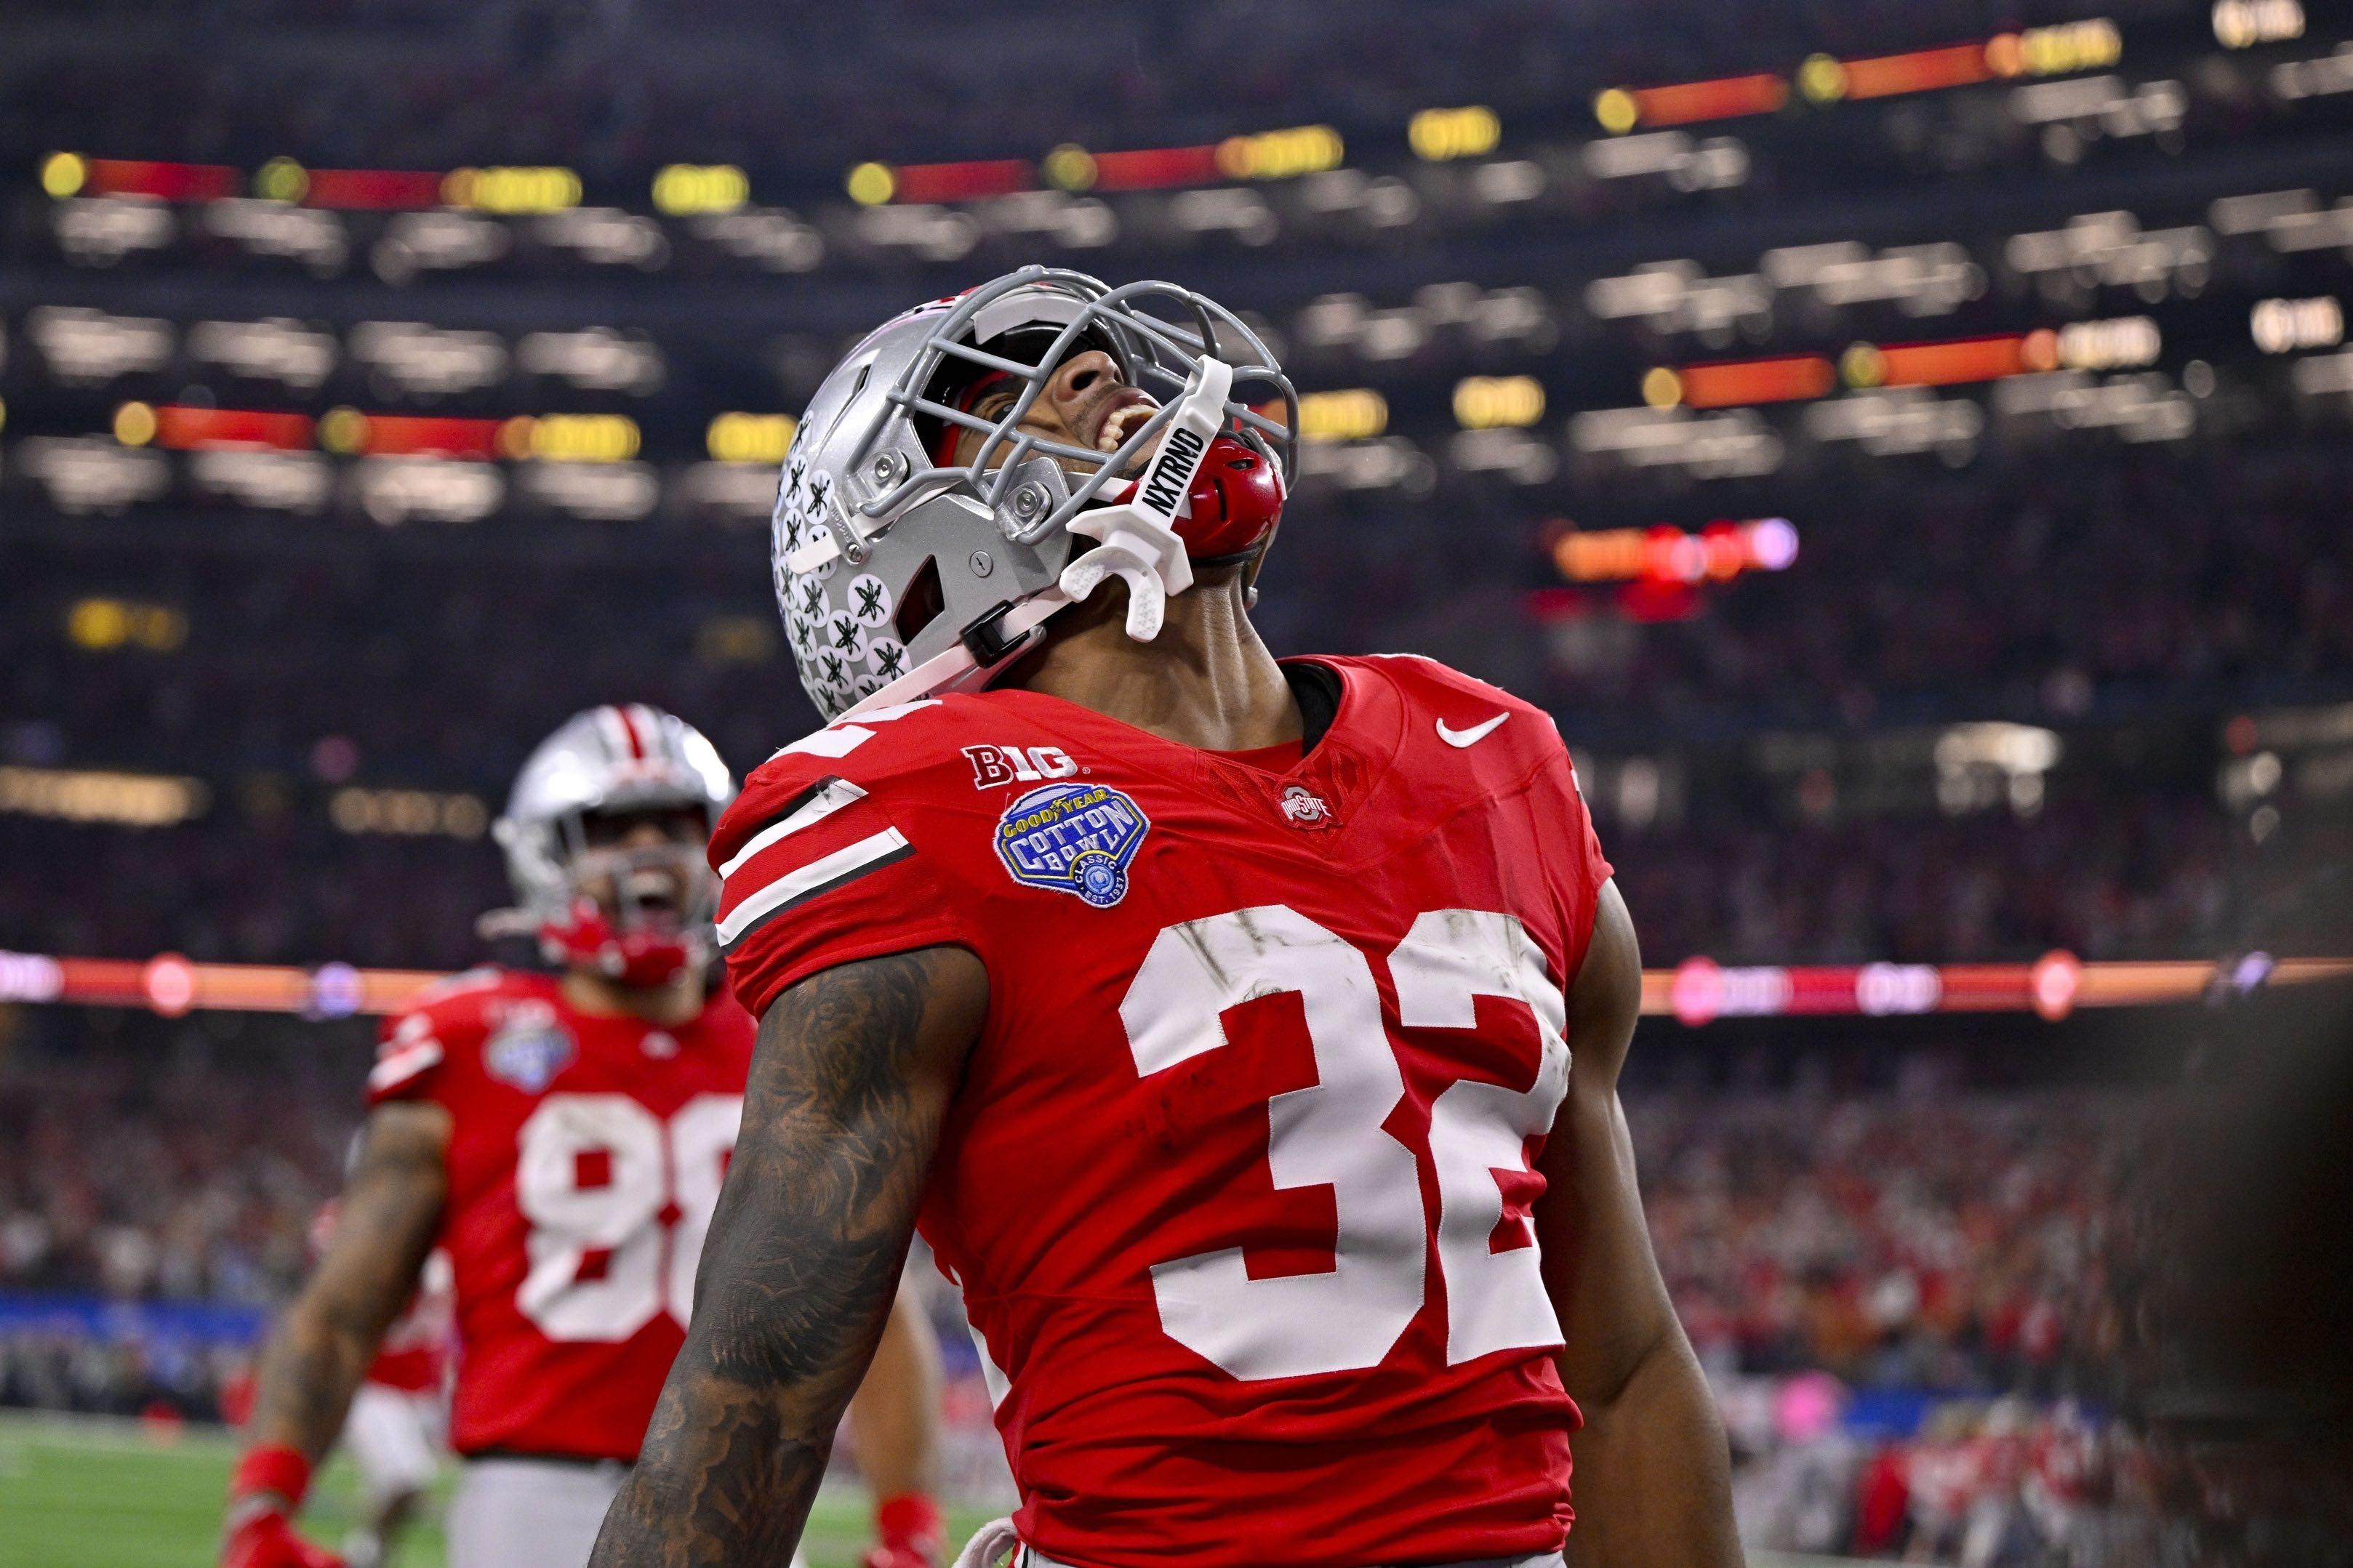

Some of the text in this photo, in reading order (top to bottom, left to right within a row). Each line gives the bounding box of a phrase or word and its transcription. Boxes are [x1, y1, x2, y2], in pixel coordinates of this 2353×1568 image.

[1142, 427, 1205, 518] NXTRND
[1295, 795, 1333, 818] STATE
[1010, 800, 1134, 870] COTTON
[1043, 829, 1121, 872] BOWL
[1075, 854, 1117, 883] CLASSIC
[1109, 877, 1125, 900] 1937
[1118, 904, 1573, 1381] 32
